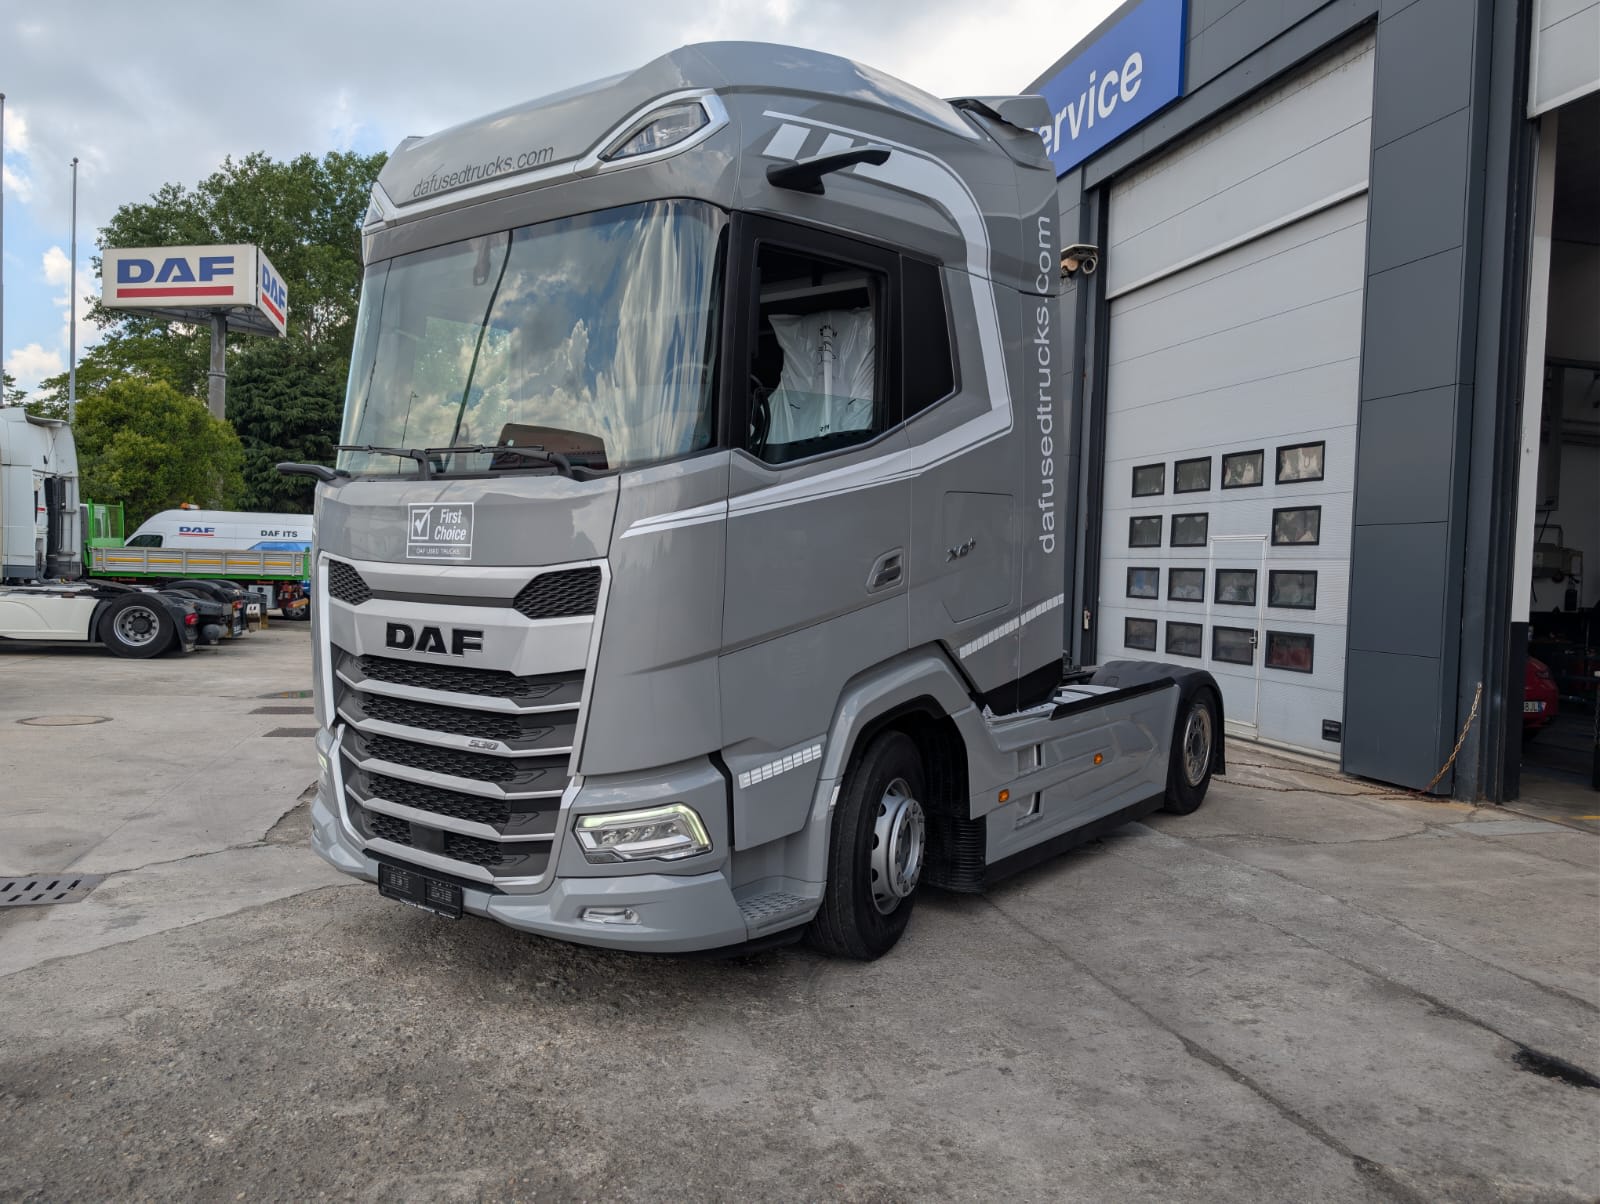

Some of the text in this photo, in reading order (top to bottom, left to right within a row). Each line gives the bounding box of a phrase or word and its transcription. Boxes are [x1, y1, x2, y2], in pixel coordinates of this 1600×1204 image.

[1023, 51, 1143, 158] ervice
[412, 145, 554, 199] dafusedtrucks.com
[116, 255, 235, 284] DAF
[261, 263, 287, 311] DAF
[1034, 216, 1055, 554] dafusedtrucks.com
[178, 526, 216, 534] DAF
[440, 508, 462, 524] First
[260, 529, 298, 538] DAF ITS
[434, 525, 467, 541] Choice
[385, 621, 485, 656] DAF
